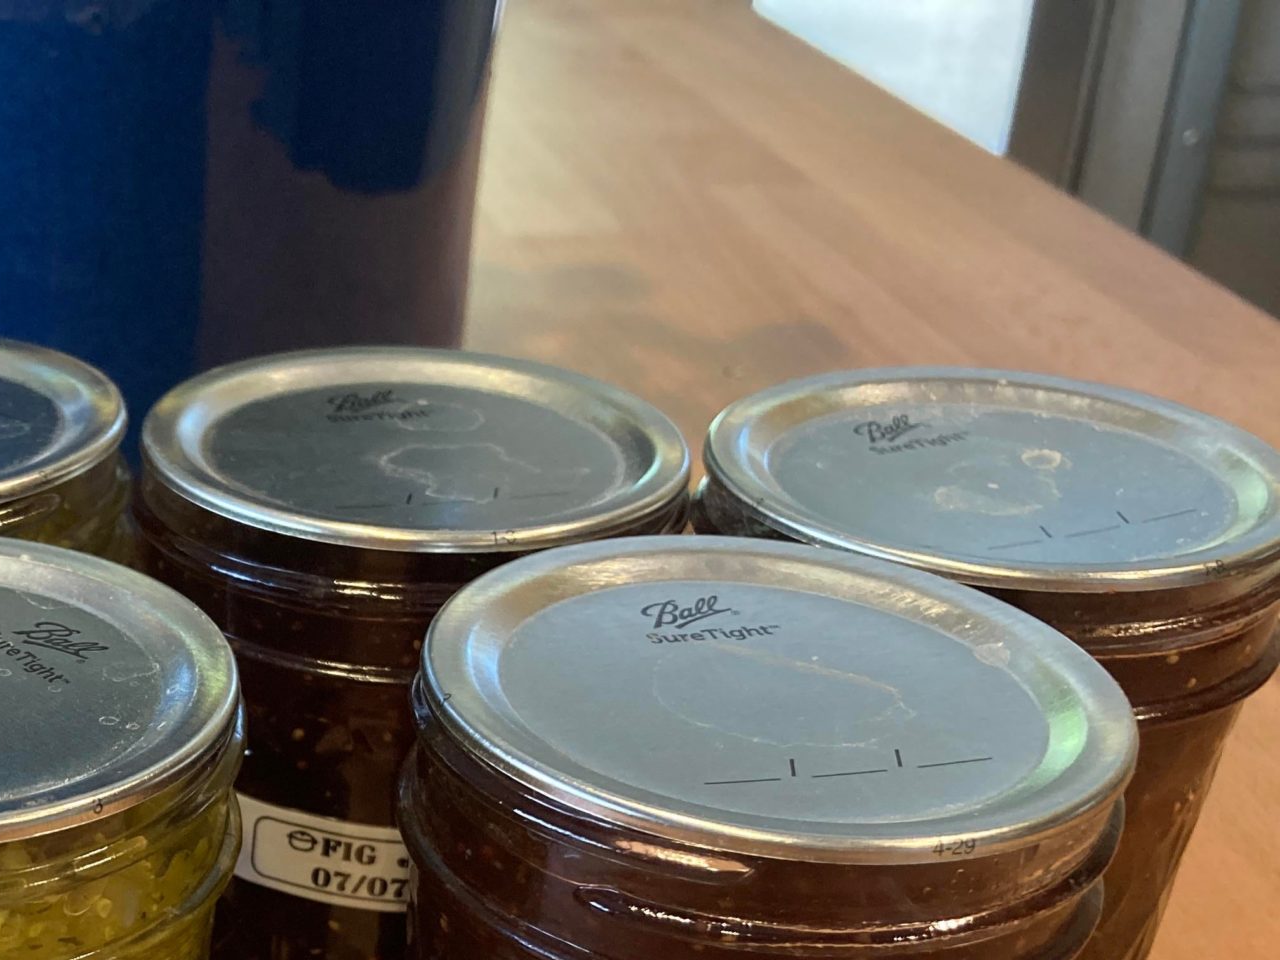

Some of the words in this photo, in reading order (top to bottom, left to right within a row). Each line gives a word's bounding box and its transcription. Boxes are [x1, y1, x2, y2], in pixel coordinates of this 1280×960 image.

[852, 414, 932, 443] Ball
[641, 595, 732, 629] Ball
[12, 621, 110, 660] Ball
[646, 625, 774, 644] SureTight
[320, 837, 377, 866] FIG
[932, 838, 977, 857] 4-29
